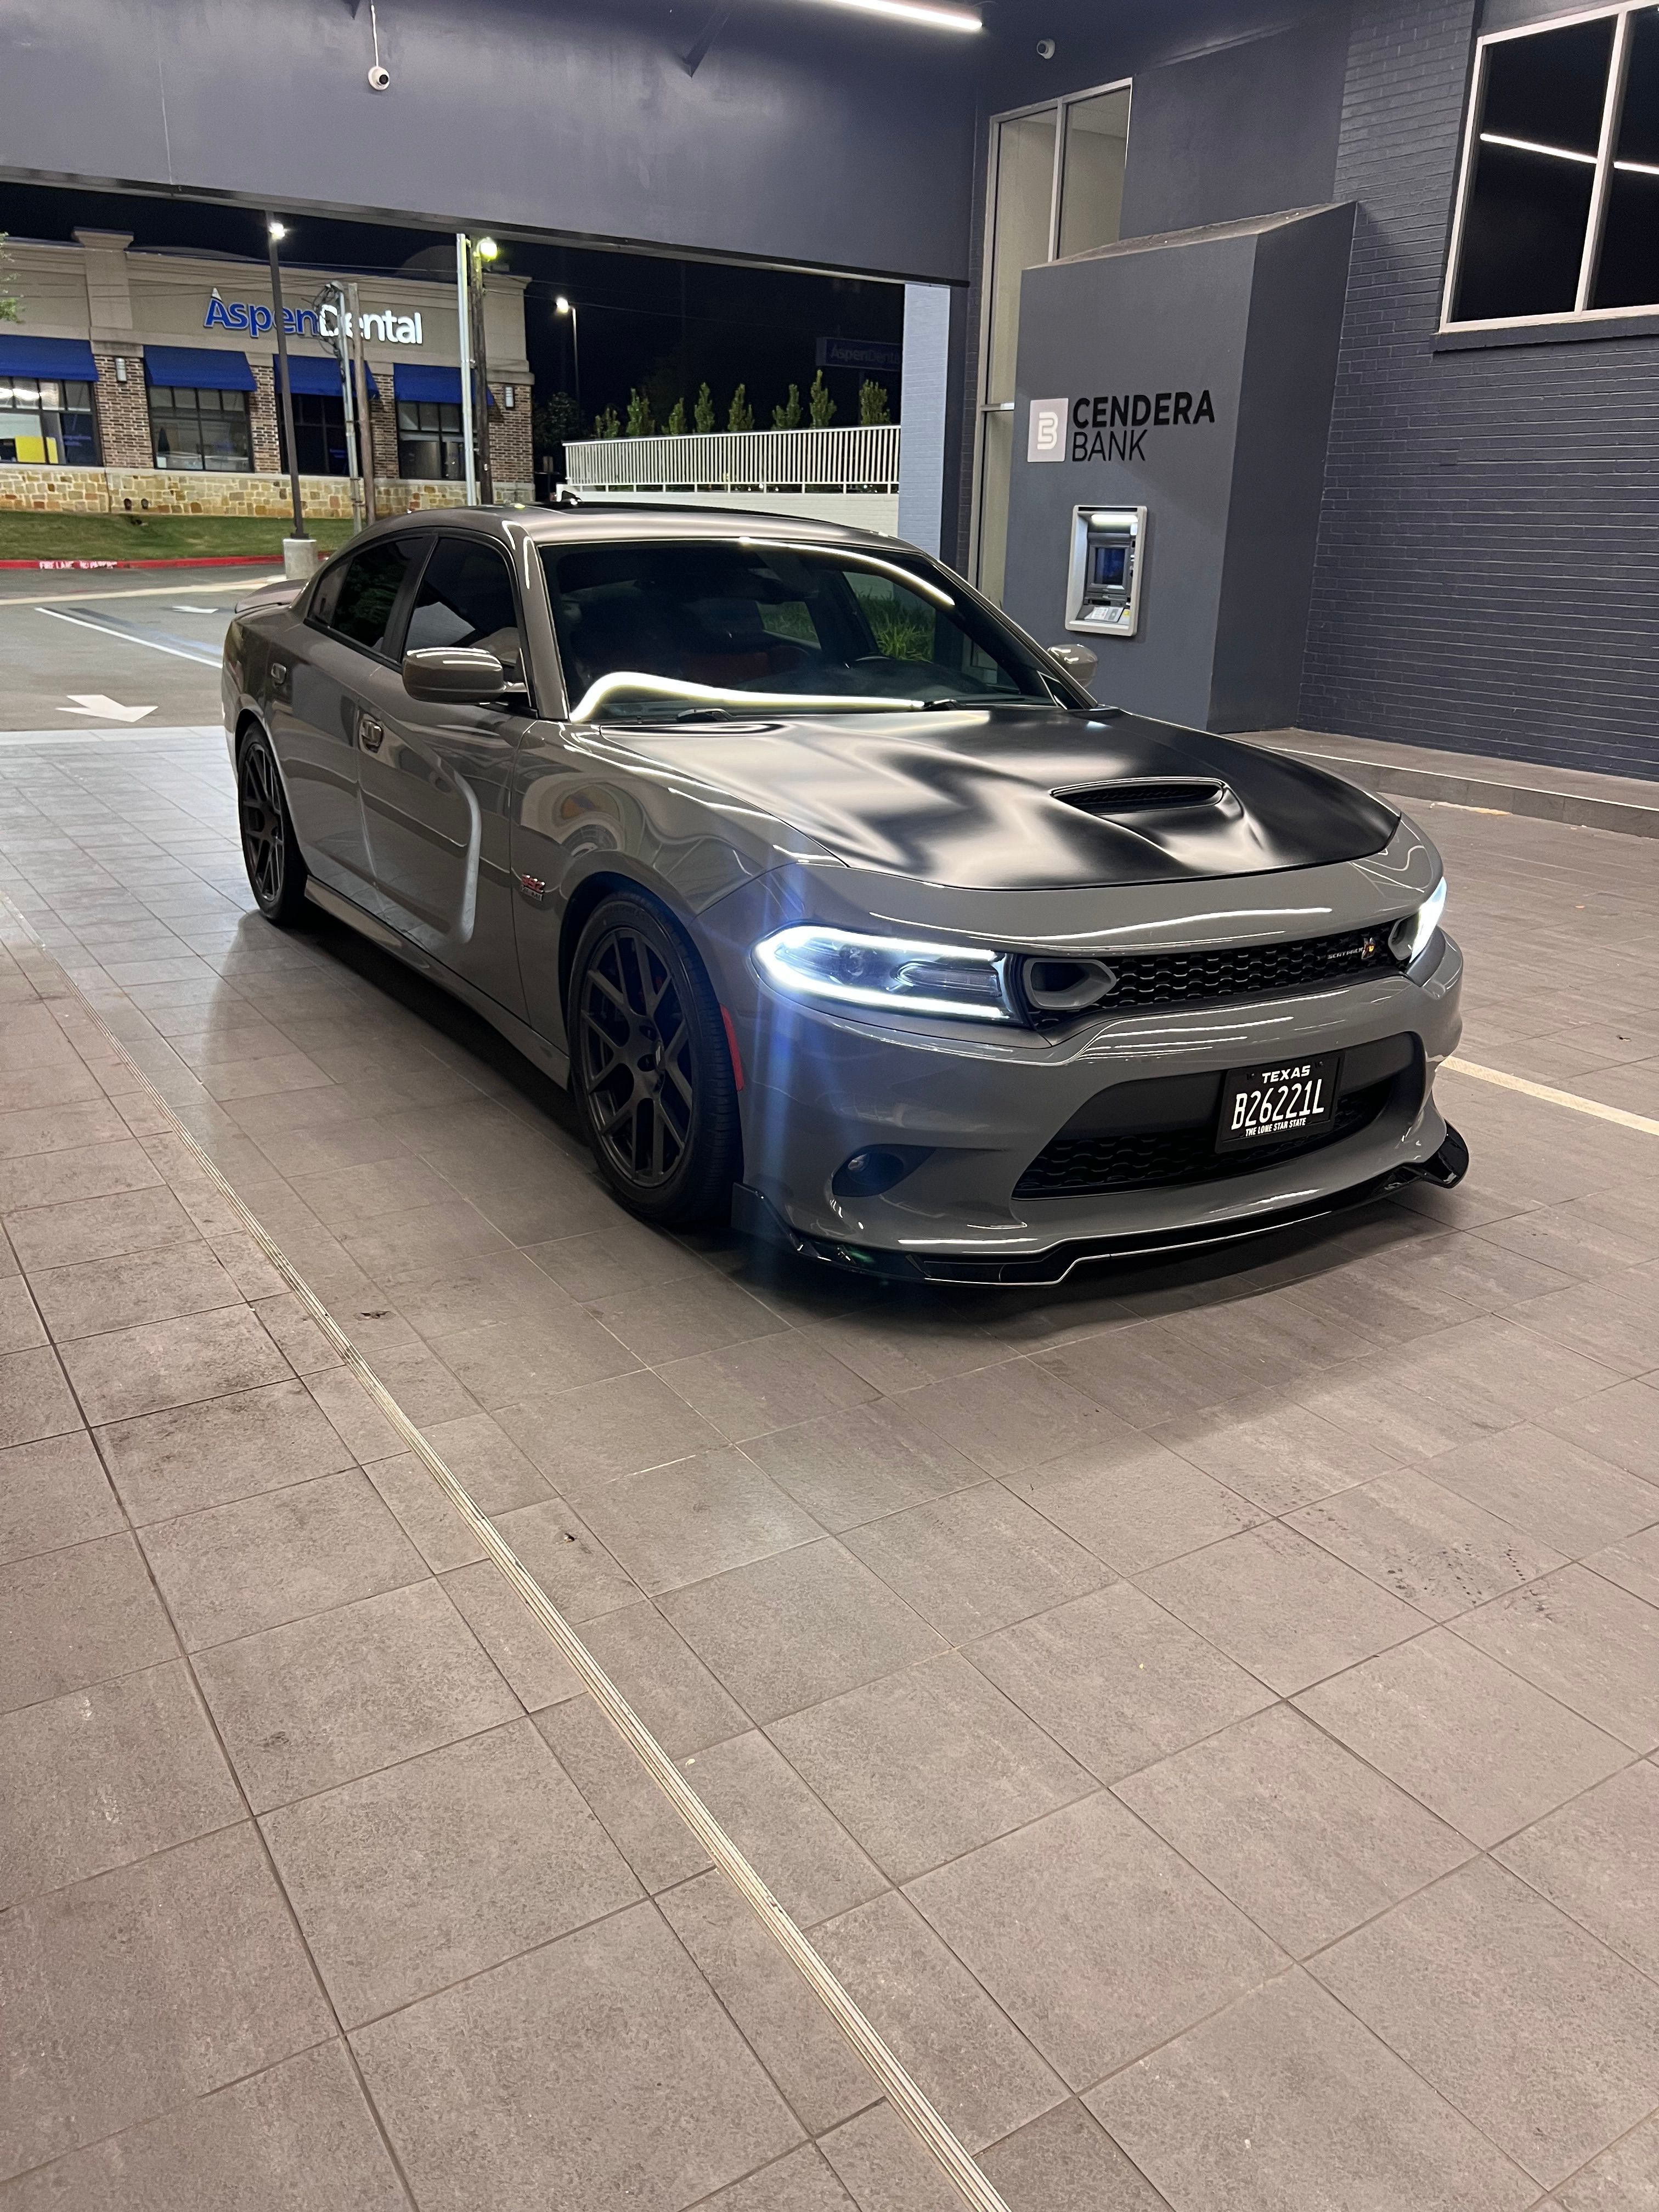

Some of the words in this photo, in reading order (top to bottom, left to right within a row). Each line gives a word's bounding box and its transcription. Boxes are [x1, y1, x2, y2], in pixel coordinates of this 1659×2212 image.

[1073, 390, 1215, 428] CENDERA
[1073, 430, 1148, 461] BANK
[1262, 1065, 1311, 1084] TEXAS
[1231, 1079, 1324, 1130] B26221L
[1245, 1128, 1257, 1137] THE
[1258, 1124, 1273, 1135] LONE
[1273, 1121, 1288, 1131] STAR
[1289, 1118, 1306, 1128] STATE
